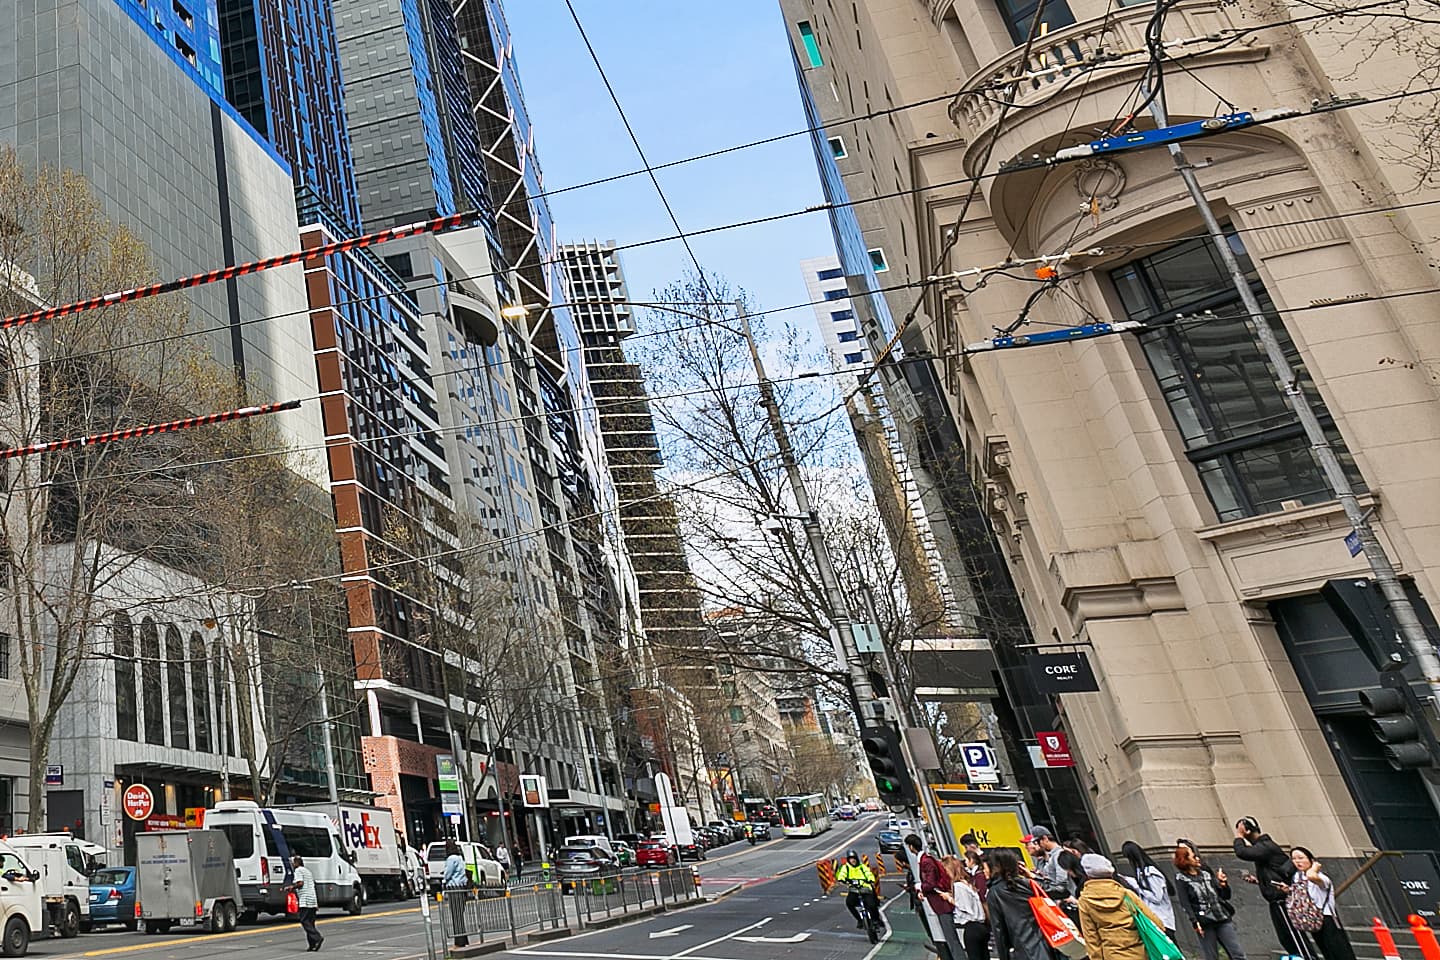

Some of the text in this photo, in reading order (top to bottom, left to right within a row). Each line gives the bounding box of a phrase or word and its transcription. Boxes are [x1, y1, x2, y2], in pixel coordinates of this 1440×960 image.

[1045, 664, 1078, 675] CORE
[968, 749, 982, 764] P
[342, 810, 383, 849] FedEx
